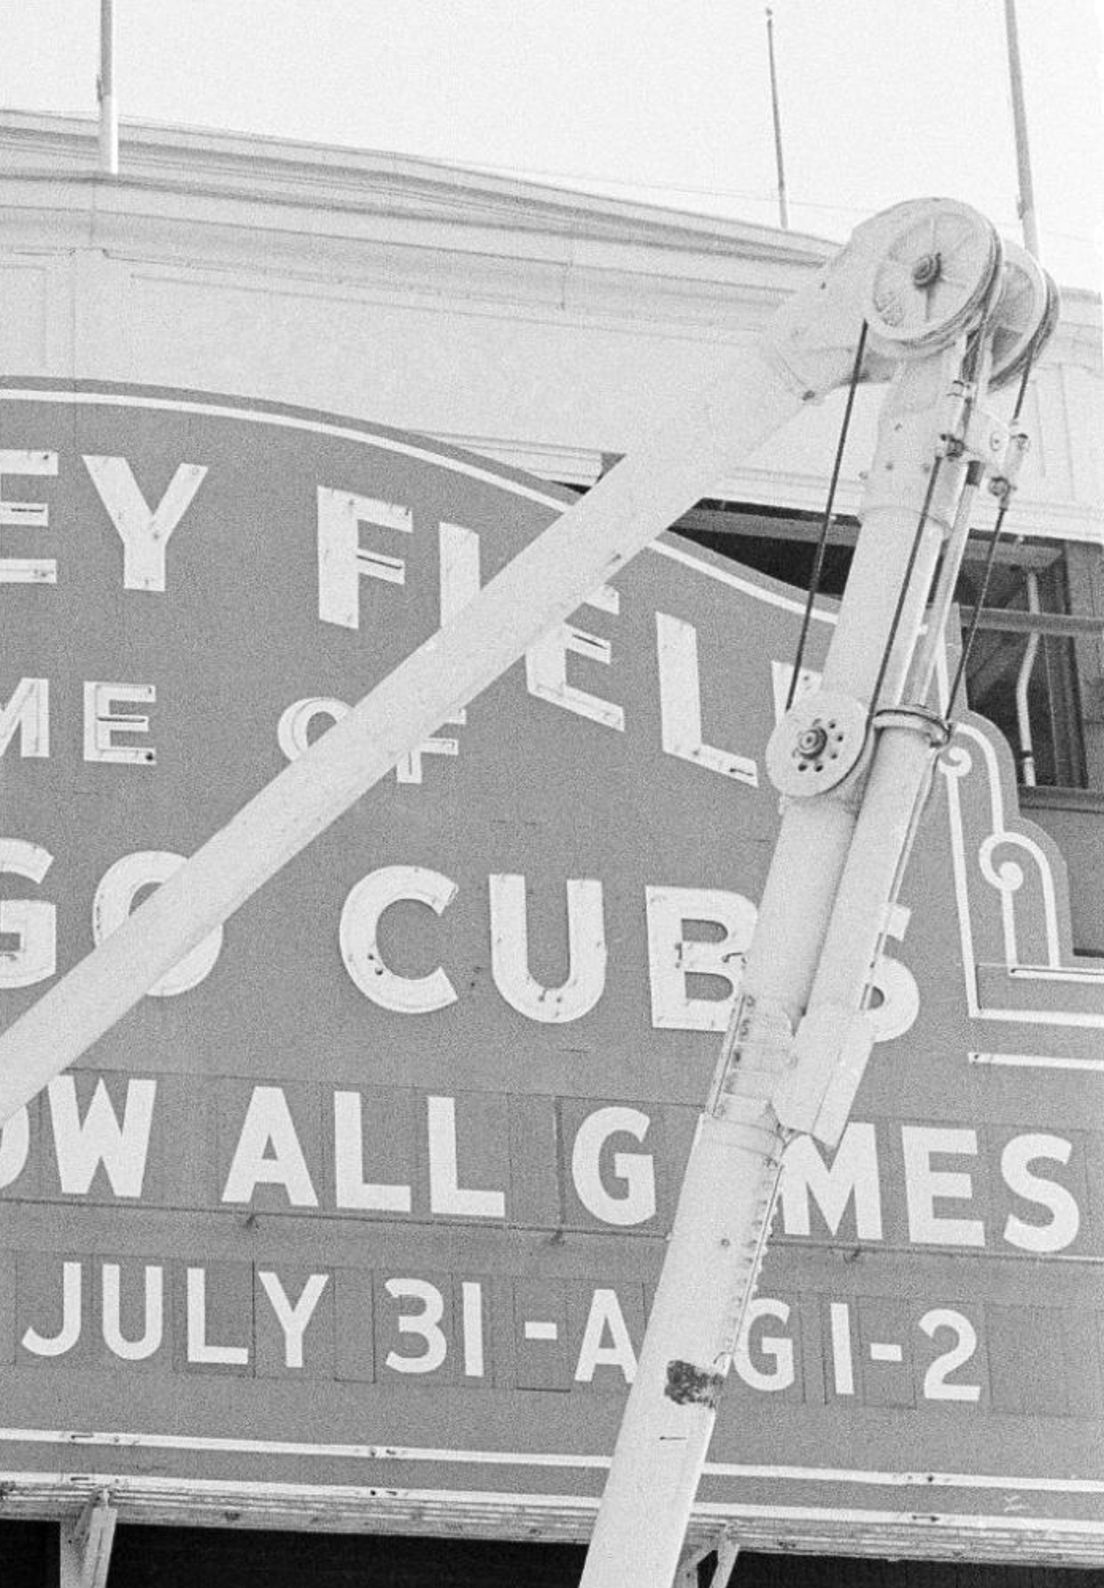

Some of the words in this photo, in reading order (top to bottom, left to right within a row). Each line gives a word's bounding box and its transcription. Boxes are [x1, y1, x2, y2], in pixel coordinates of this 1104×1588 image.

[317, 485, 823, 788] FIEL
[222, 1085, 505, 1217] ALL
[572, 1107, 1080, 1252] GMES
[21, 1262, 328, 1367] JULY
